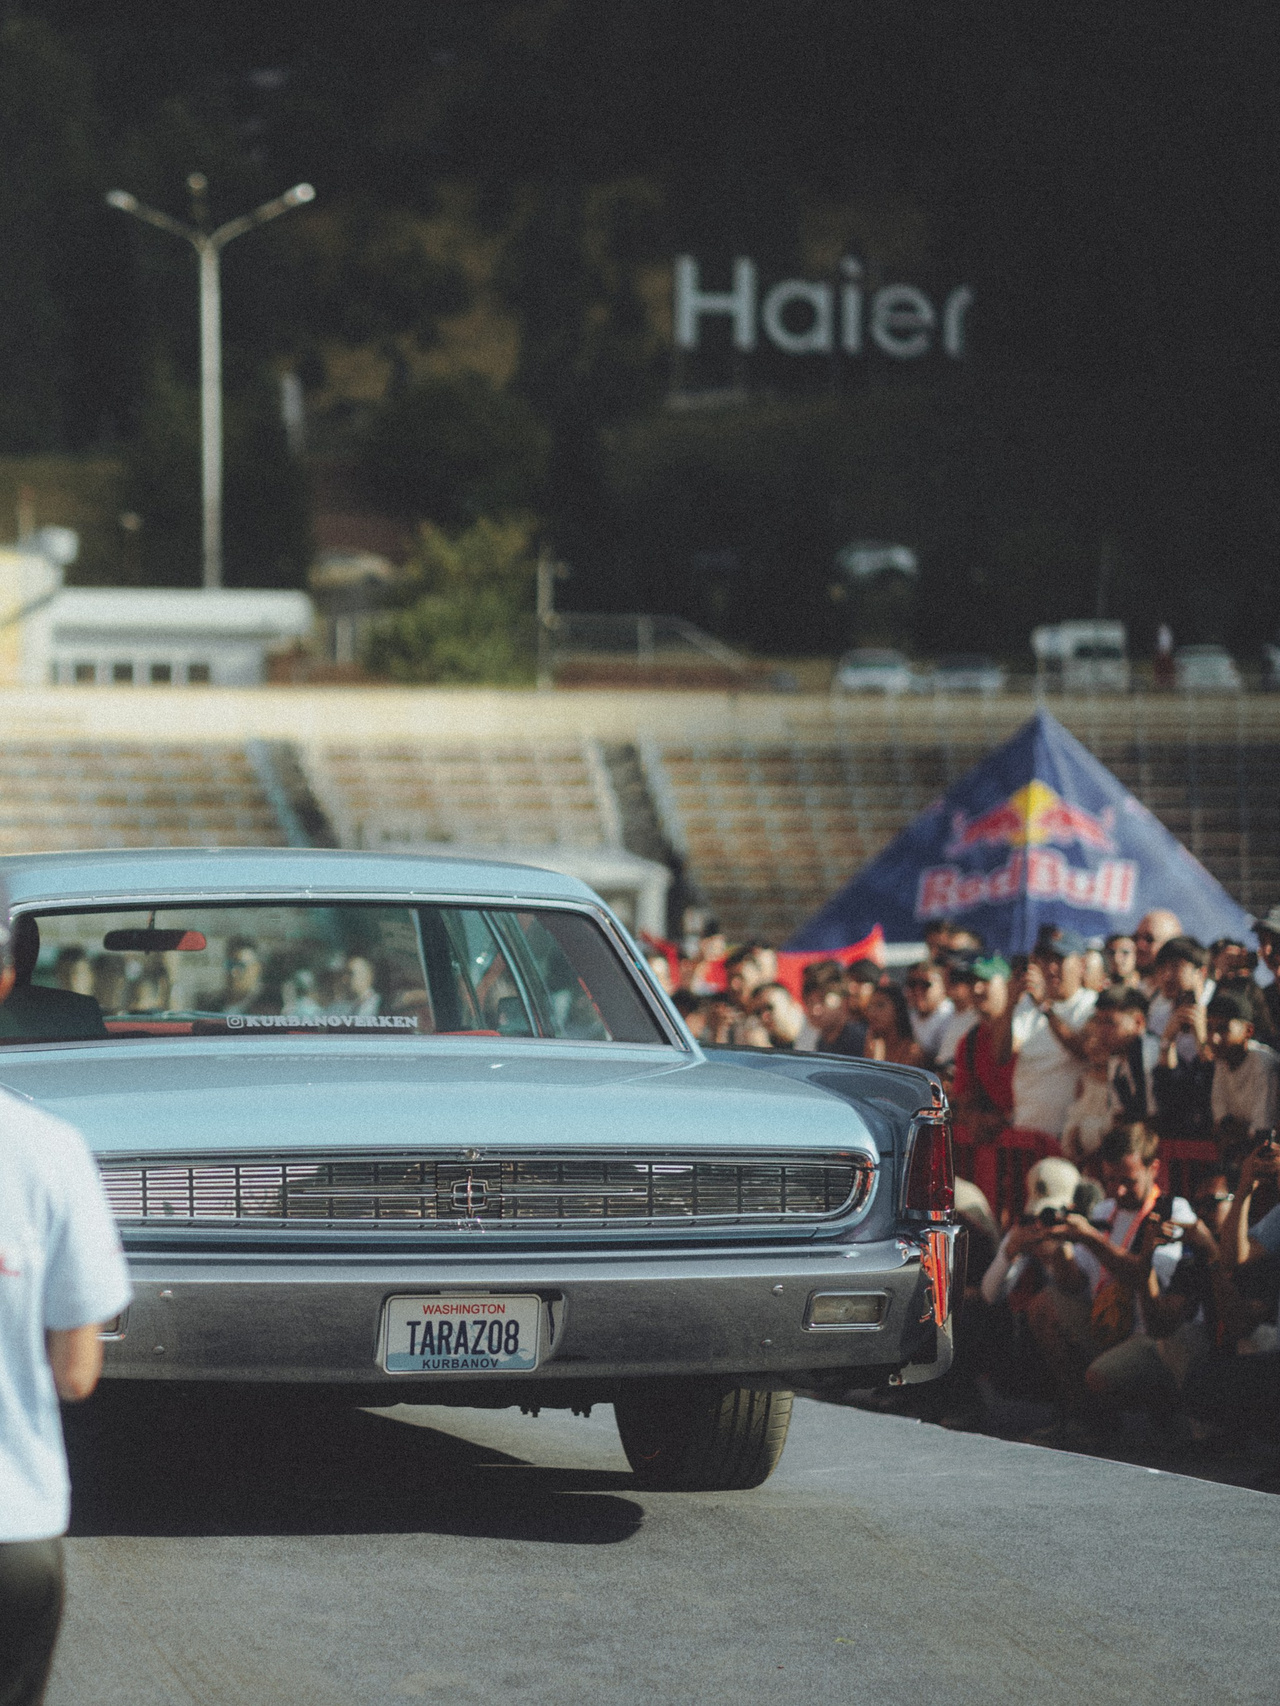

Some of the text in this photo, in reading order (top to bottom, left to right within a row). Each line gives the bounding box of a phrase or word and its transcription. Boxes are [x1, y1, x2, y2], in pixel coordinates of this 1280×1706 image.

[675, 254, 974, 357] Haier
[919, 850, 1135, 919] Red Bull
[422, 1303, 506, 1315] WASHINGTON
[406, 1319, 520, 1356] TARAZ08
[422, 1358, 499, 1369] KURBANOV
